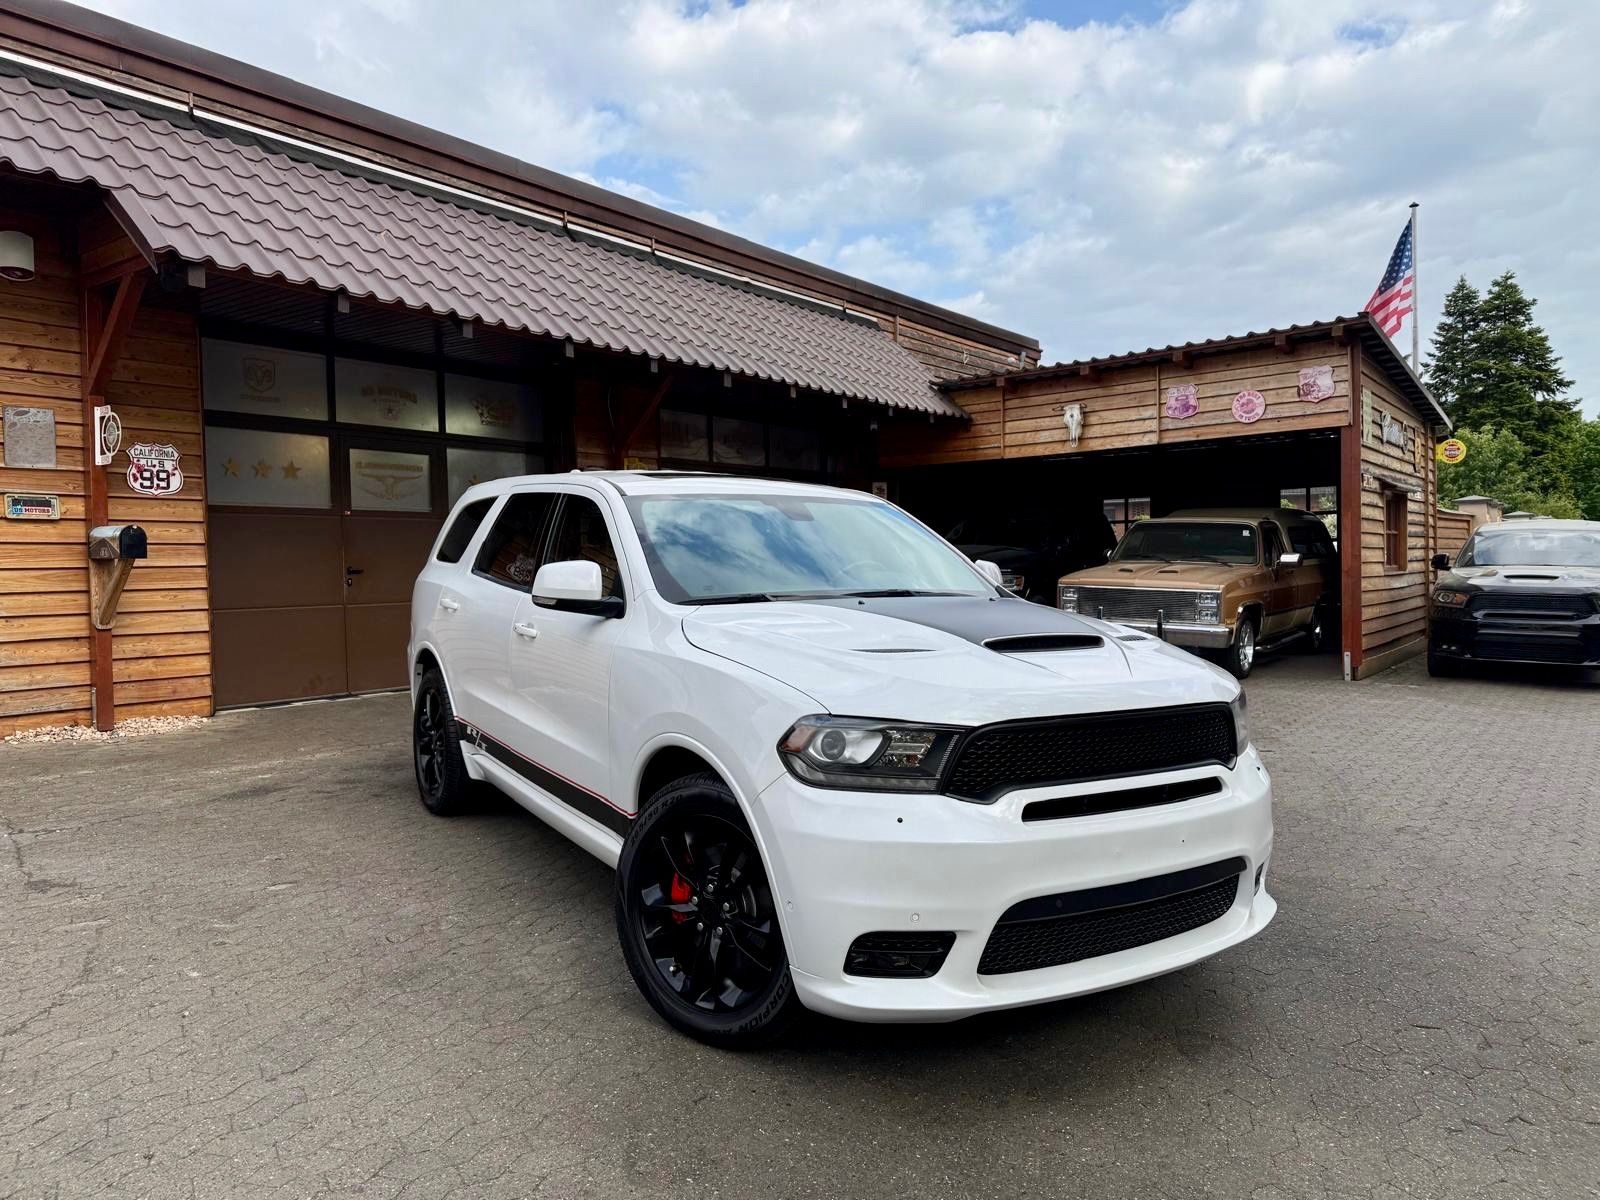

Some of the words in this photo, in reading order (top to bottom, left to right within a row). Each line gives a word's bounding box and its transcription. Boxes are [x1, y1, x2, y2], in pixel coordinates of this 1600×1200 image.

[133, 447, 175, 459] CALIFORNIA
[140, 468, 170, 490] 99
[466, 726, 488, 751] R/T
